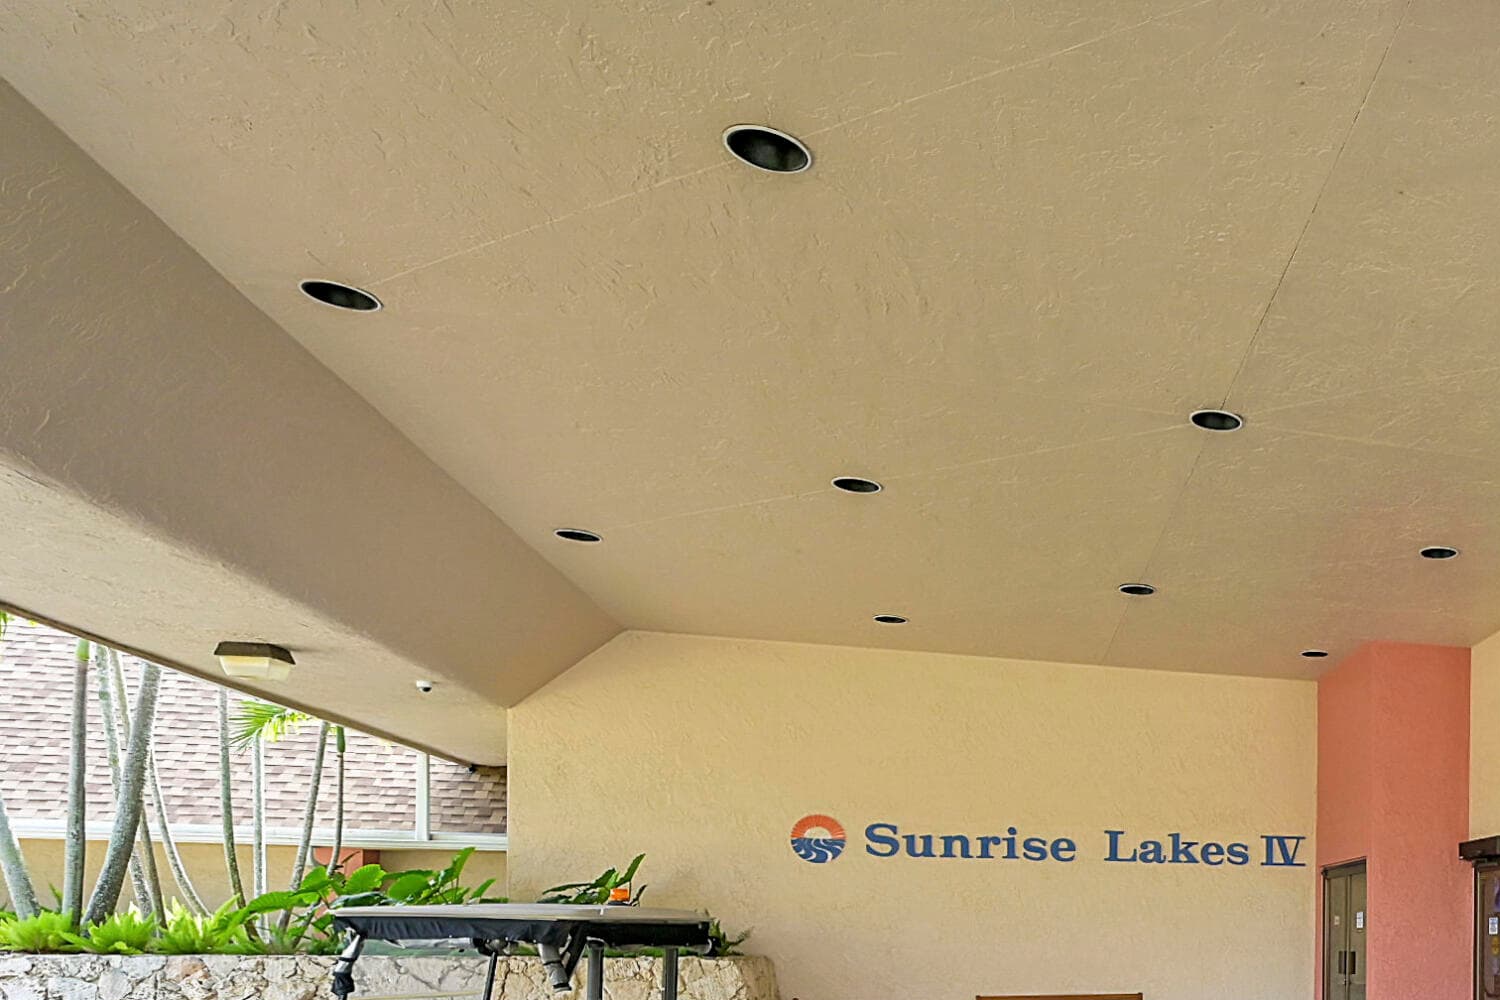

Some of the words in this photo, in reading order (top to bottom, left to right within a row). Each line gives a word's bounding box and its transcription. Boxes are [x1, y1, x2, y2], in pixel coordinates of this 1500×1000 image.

[865, 823, 1077, 862] Sunrise
[1104, 830, 1249, 865] Lakes
[1260, 835, 1306, 867] IV
